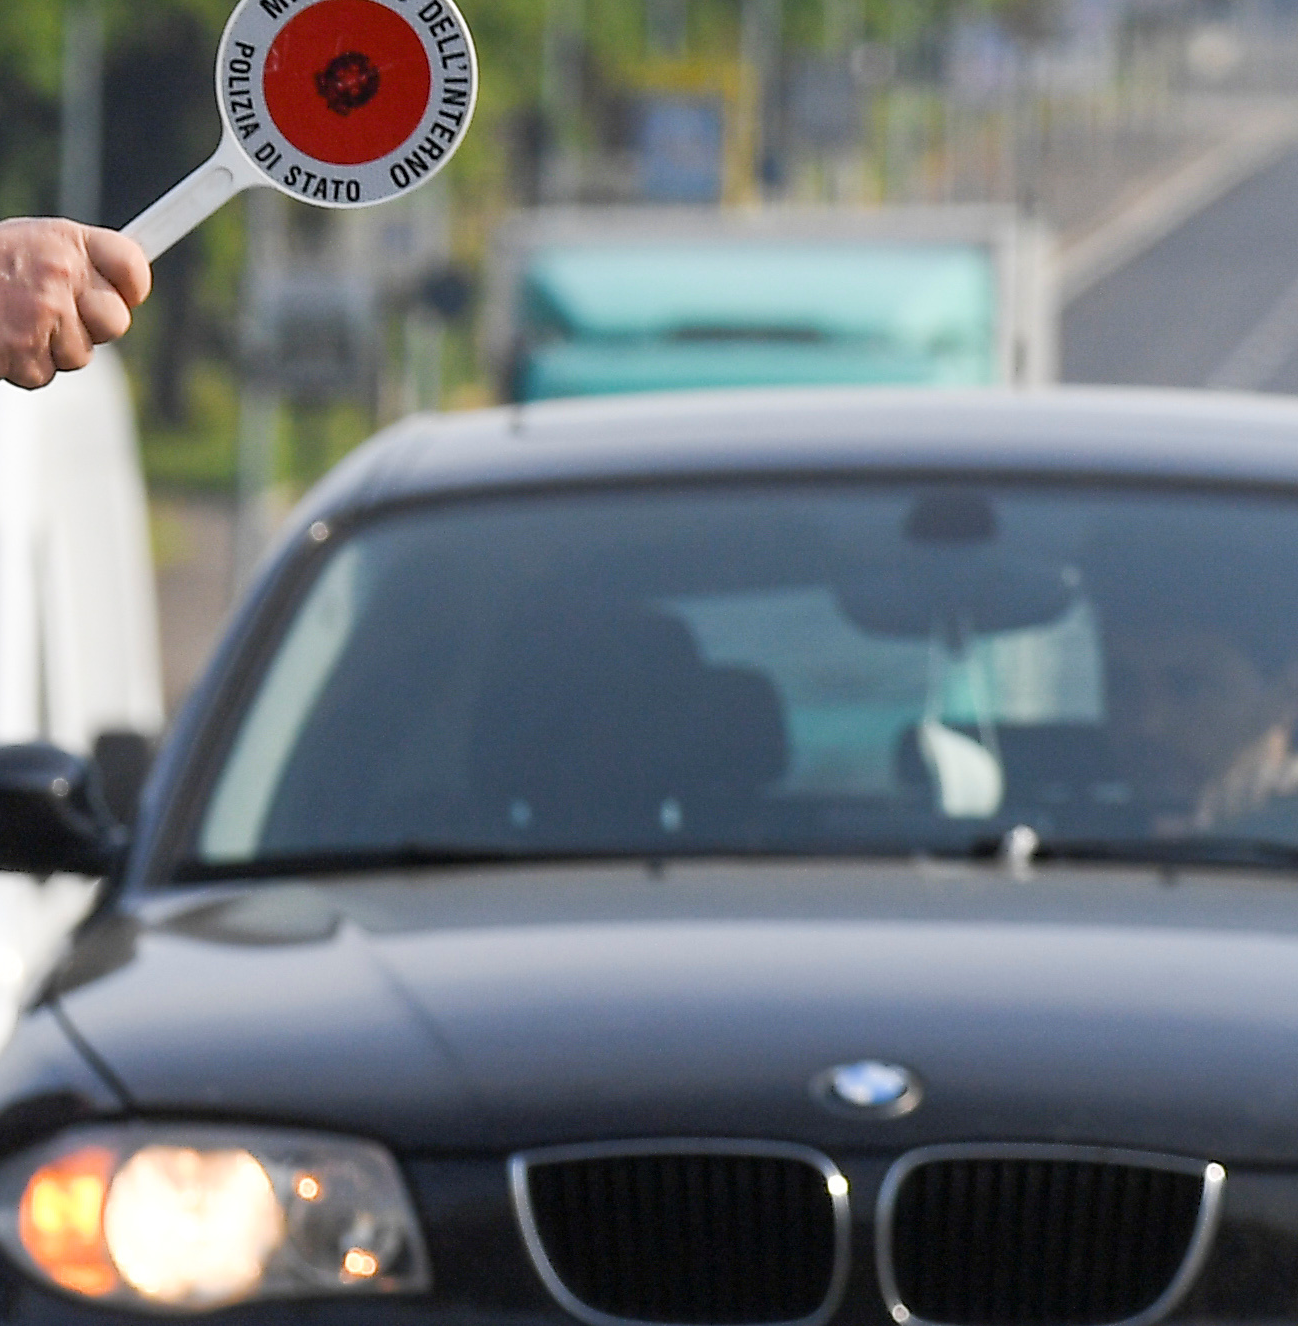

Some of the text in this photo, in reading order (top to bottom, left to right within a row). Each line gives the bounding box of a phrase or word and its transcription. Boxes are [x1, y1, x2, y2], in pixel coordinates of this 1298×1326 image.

[229, 41, 360, 202] POLIZIA DI STATO
[389, 0, 468, 188] DELL'INTERNO
